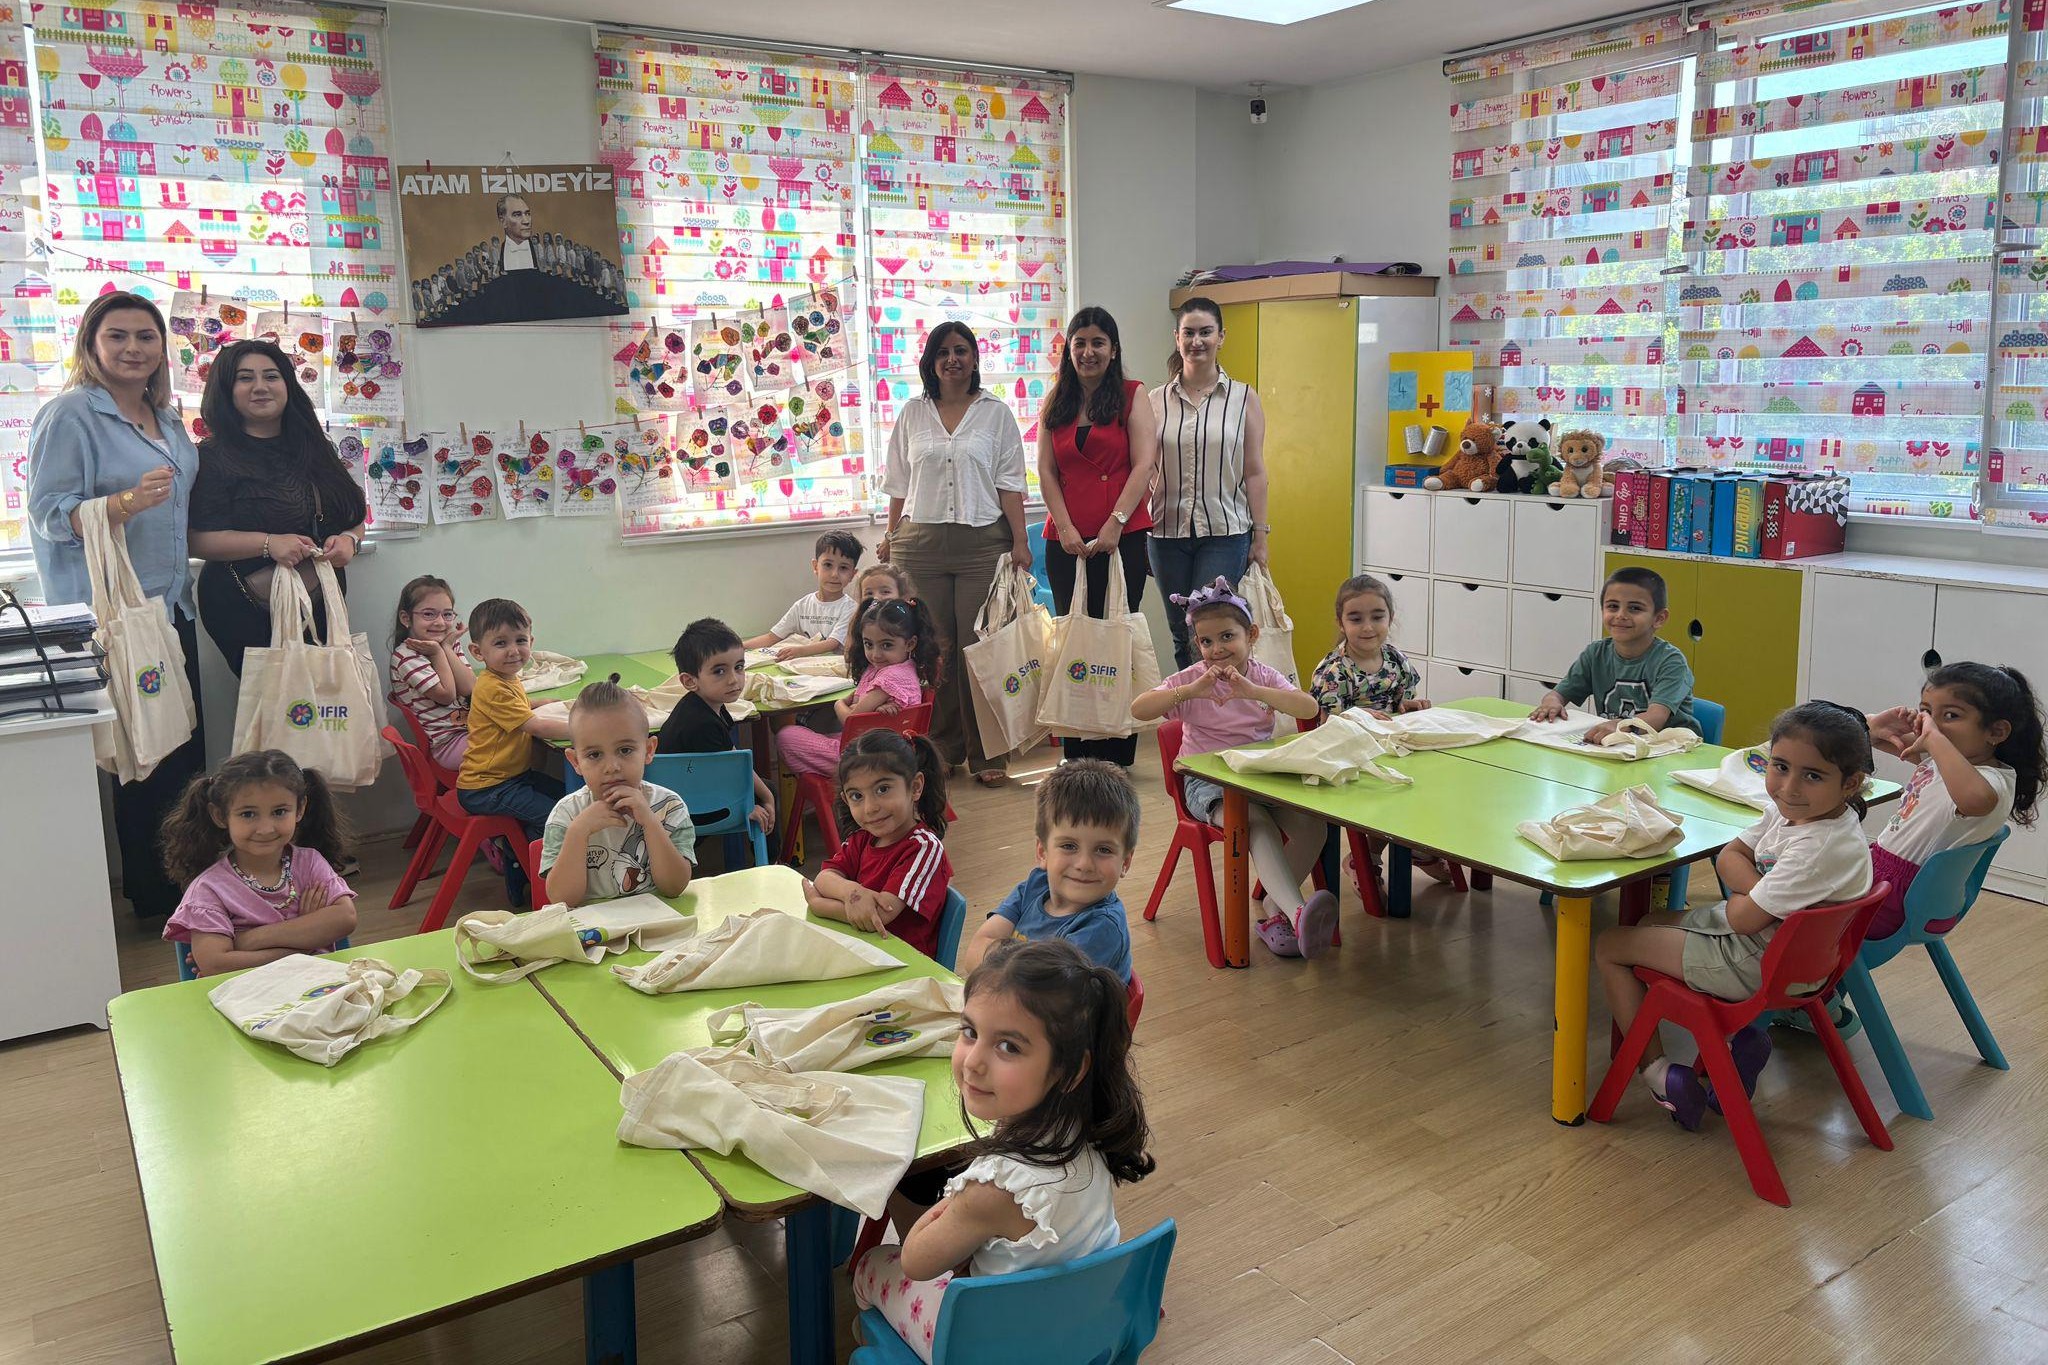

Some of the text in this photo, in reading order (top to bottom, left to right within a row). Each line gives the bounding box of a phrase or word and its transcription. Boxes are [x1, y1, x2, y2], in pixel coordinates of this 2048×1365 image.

[1635, 74, 1664, 87] flowers
[149, 84, 192, 99] flowers
[1841, 90, 1877, 102] flowers
[642, 122, 673, 134] flowers
[810, 137, 838, 150] flowers
[975, 151, 1000, 162] flowers
[401, 166, 613, 195] ATAM İZİNDEYİZ
[0, 209, 23, 219] ouse
[1850, 323, 1872, 333] house
[1398, 376, 1407, 398] 4
[0, 416, 32, 428] owers
[1617, 504, 1629, 535] GIRLS
[1735, 486, 1751, 553] SHOPPING
[1090, 664, 1117, 677] SIFIR
[1089, 676, 1117, 687] ATIK
[319, 718, 348, 731] TIK
